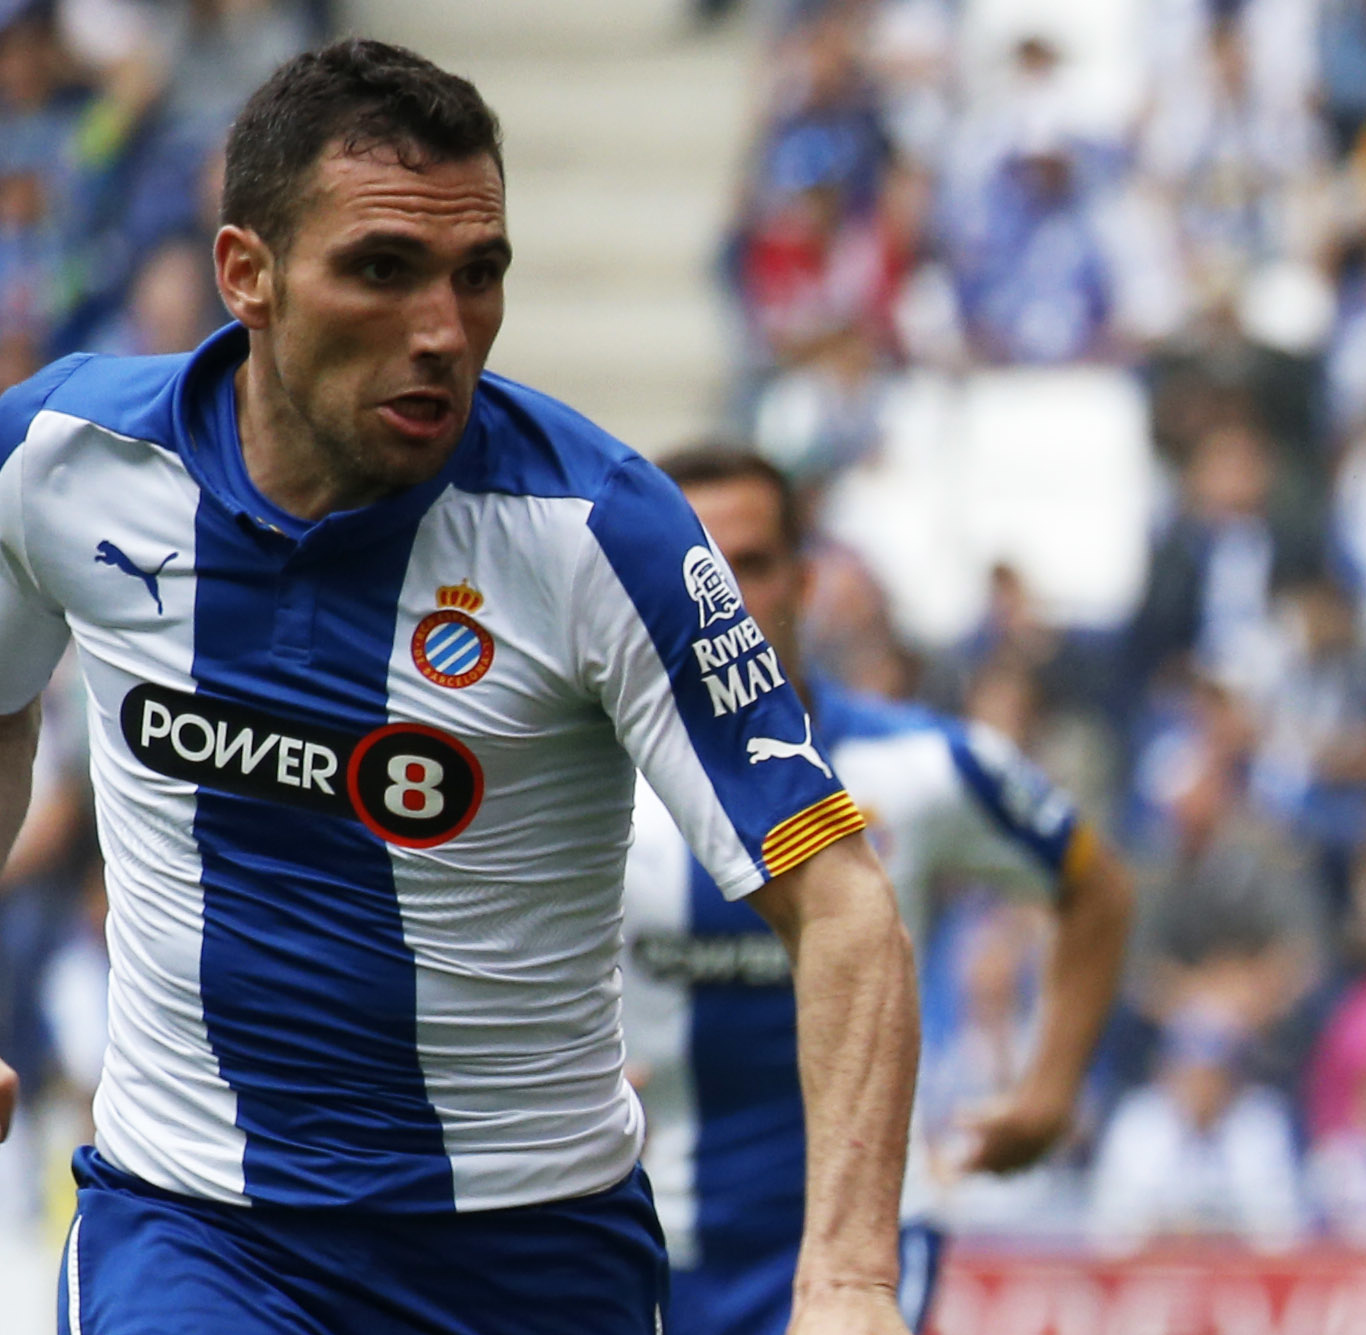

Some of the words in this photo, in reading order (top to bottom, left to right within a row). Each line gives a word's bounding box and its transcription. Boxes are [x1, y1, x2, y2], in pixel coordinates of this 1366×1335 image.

[700, 646, 786, 718] MAY
[140, 699, 338, 796] POWER
[384, 754, 445, 819] 8
